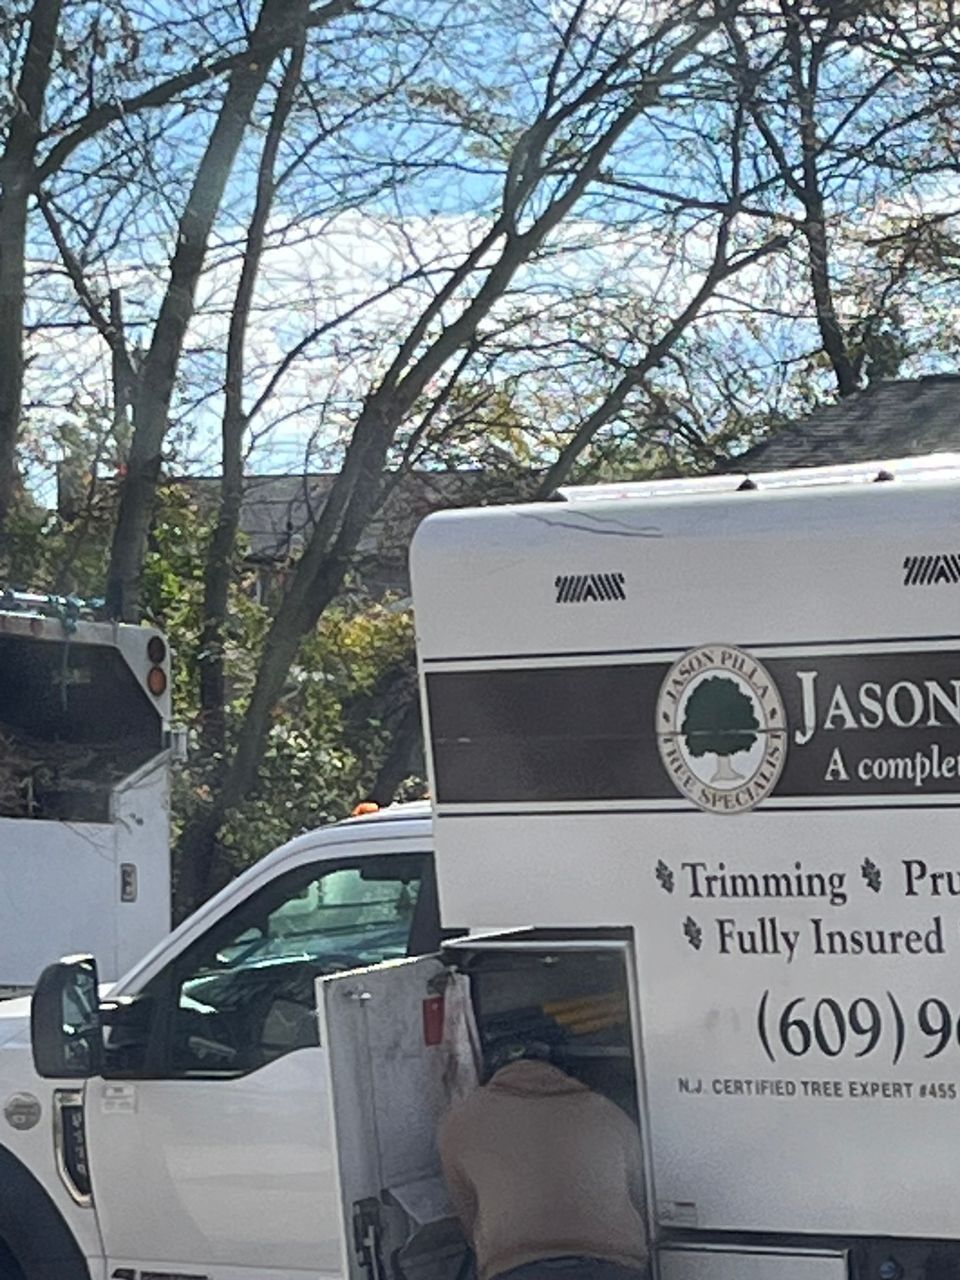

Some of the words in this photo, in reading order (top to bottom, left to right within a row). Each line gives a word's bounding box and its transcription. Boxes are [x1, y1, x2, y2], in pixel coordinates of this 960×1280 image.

[666, 650, 715, 702] JASON
[720, 650, 769, 699] PILLA
[826, 749, 848, 780] A
[682, 862, 847, 905] Trimming
[716, 917, 799, 962] Fully
[811, 917, 944, 954] Insured
[758, 991, 904, 1064] (609)
[711, 1078, 796, 1097] CERTIFIED
[800, 1080, 843, 1098] TREE
[848, 1081, 913, 1098] EXPERT
[919, 1082, 957, 1100] #455
